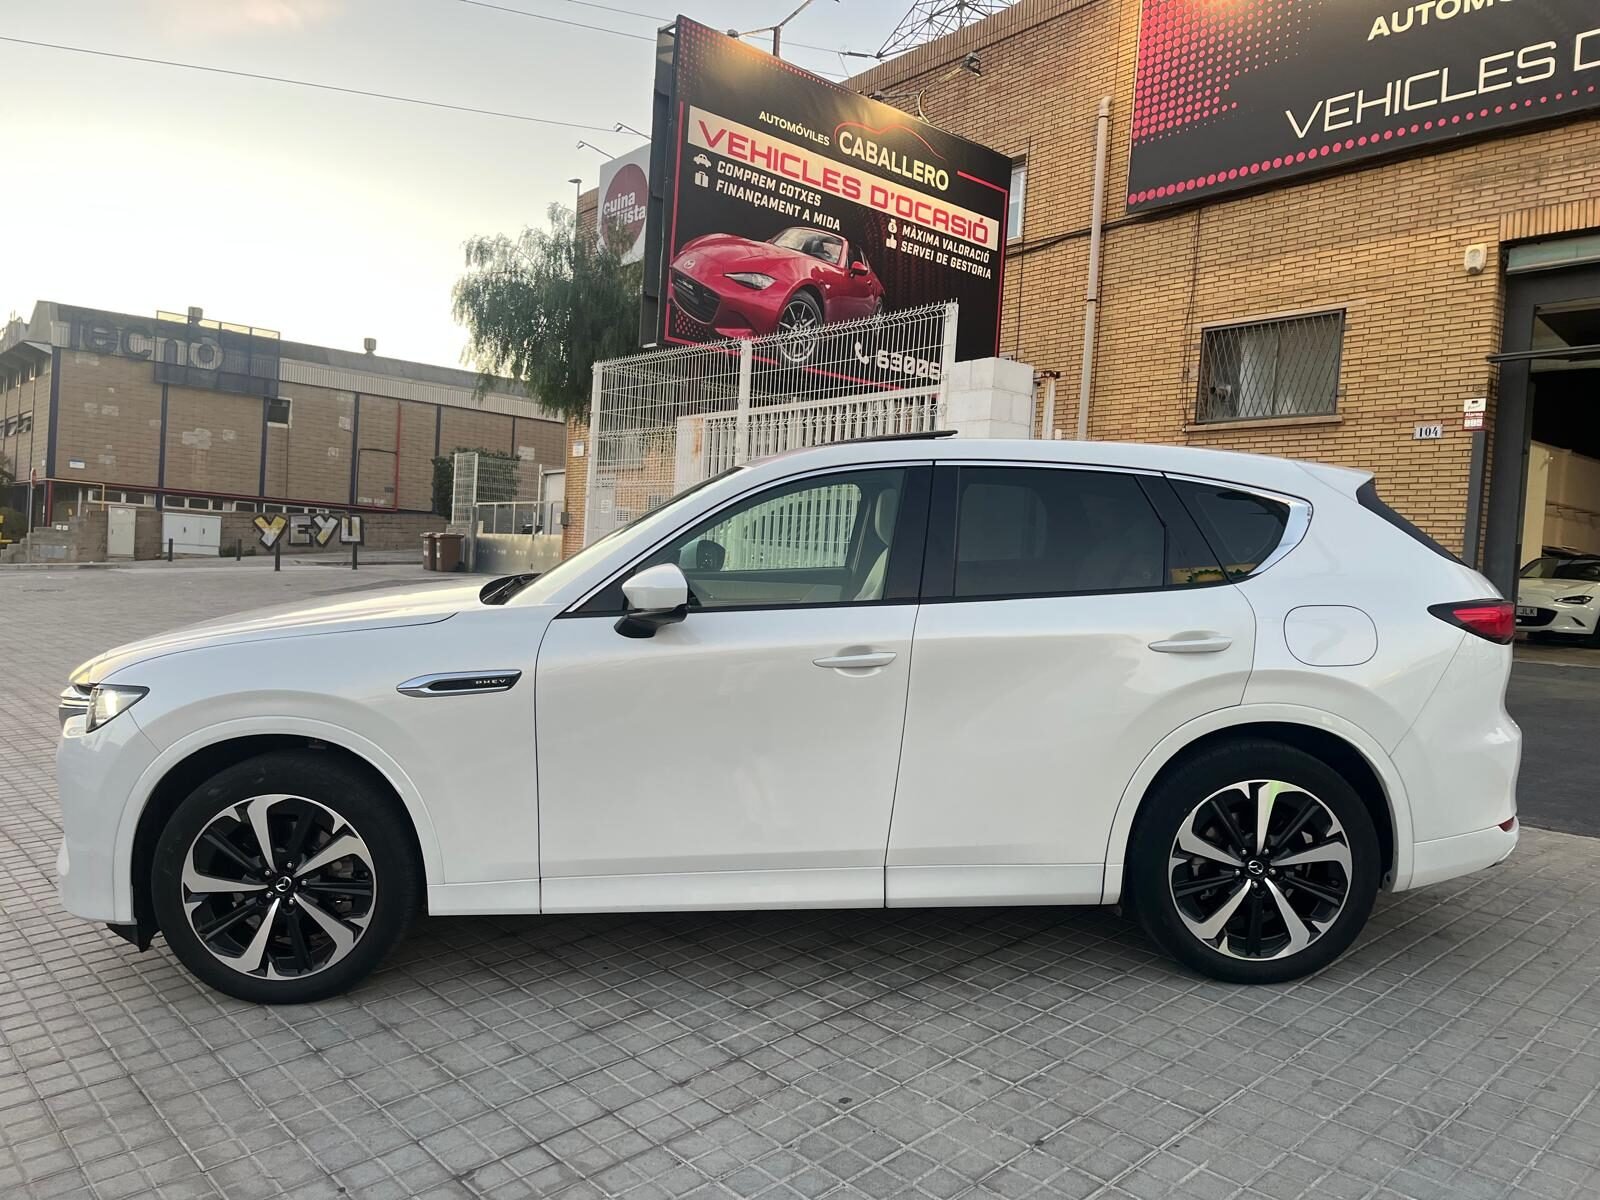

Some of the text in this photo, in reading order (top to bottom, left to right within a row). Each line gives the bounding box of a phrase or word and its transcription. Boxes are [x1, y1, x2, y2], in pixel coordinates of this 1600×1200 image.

[1368, 0, 1513, 41] AUTOM
[1285, 40, 1557, 139] VEHICLES
[758, 111, 949, 191] AUTOMÓVILES CABALLERO
[698, 119, 989, 244] VEHICLES D'OCASIÓ
[717, 160, 822, 207] COMPREM COTXES
[716, 179, 841, 232] FINANÇAMENT A MIDA
[900, 241, 992, 280] SERVEI DE GESTORIA
[902, 224, 990, 264] MÀXIMA VALORACIÓ
[1419, 426, 1438, 437] 104
